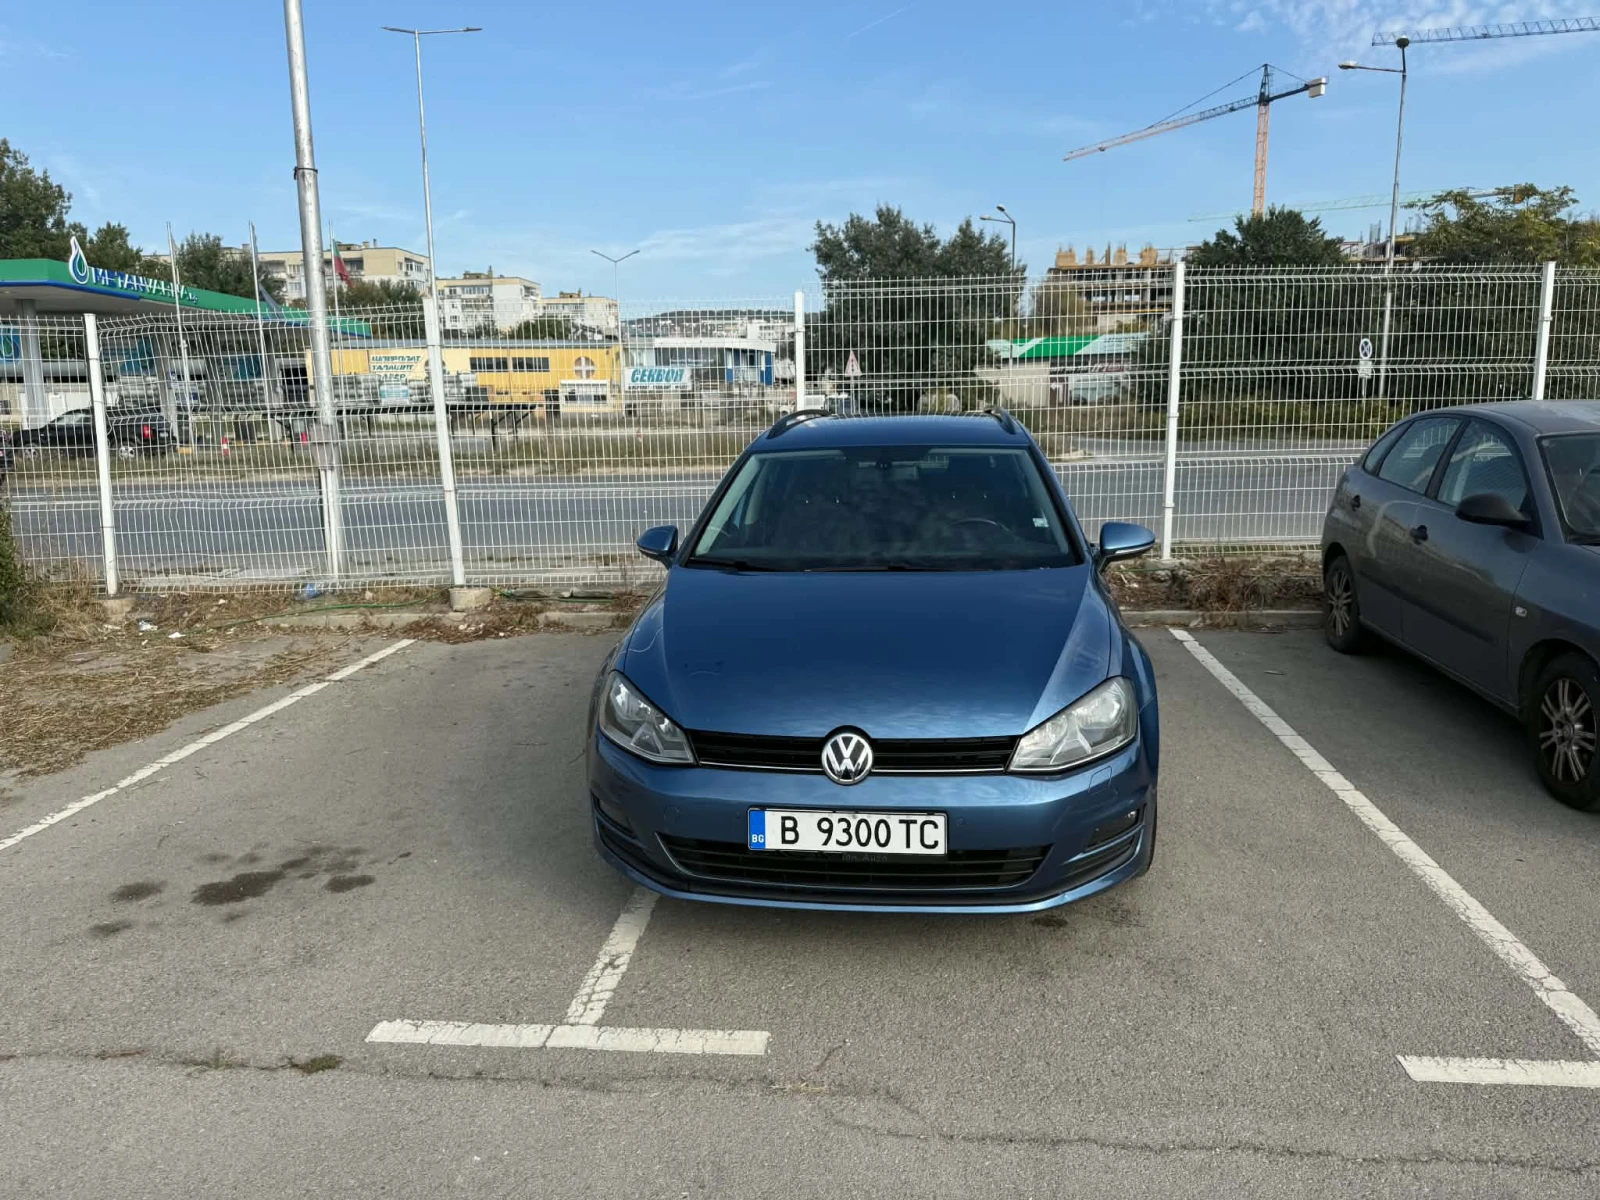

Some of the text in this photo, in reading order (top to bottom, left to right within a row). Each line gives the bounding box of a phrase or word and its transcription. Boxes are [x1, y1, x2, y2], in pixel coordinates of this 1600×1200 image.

[751, 833, 765, 844] BG
[780, 815, 940, 850] B 9300 TC
